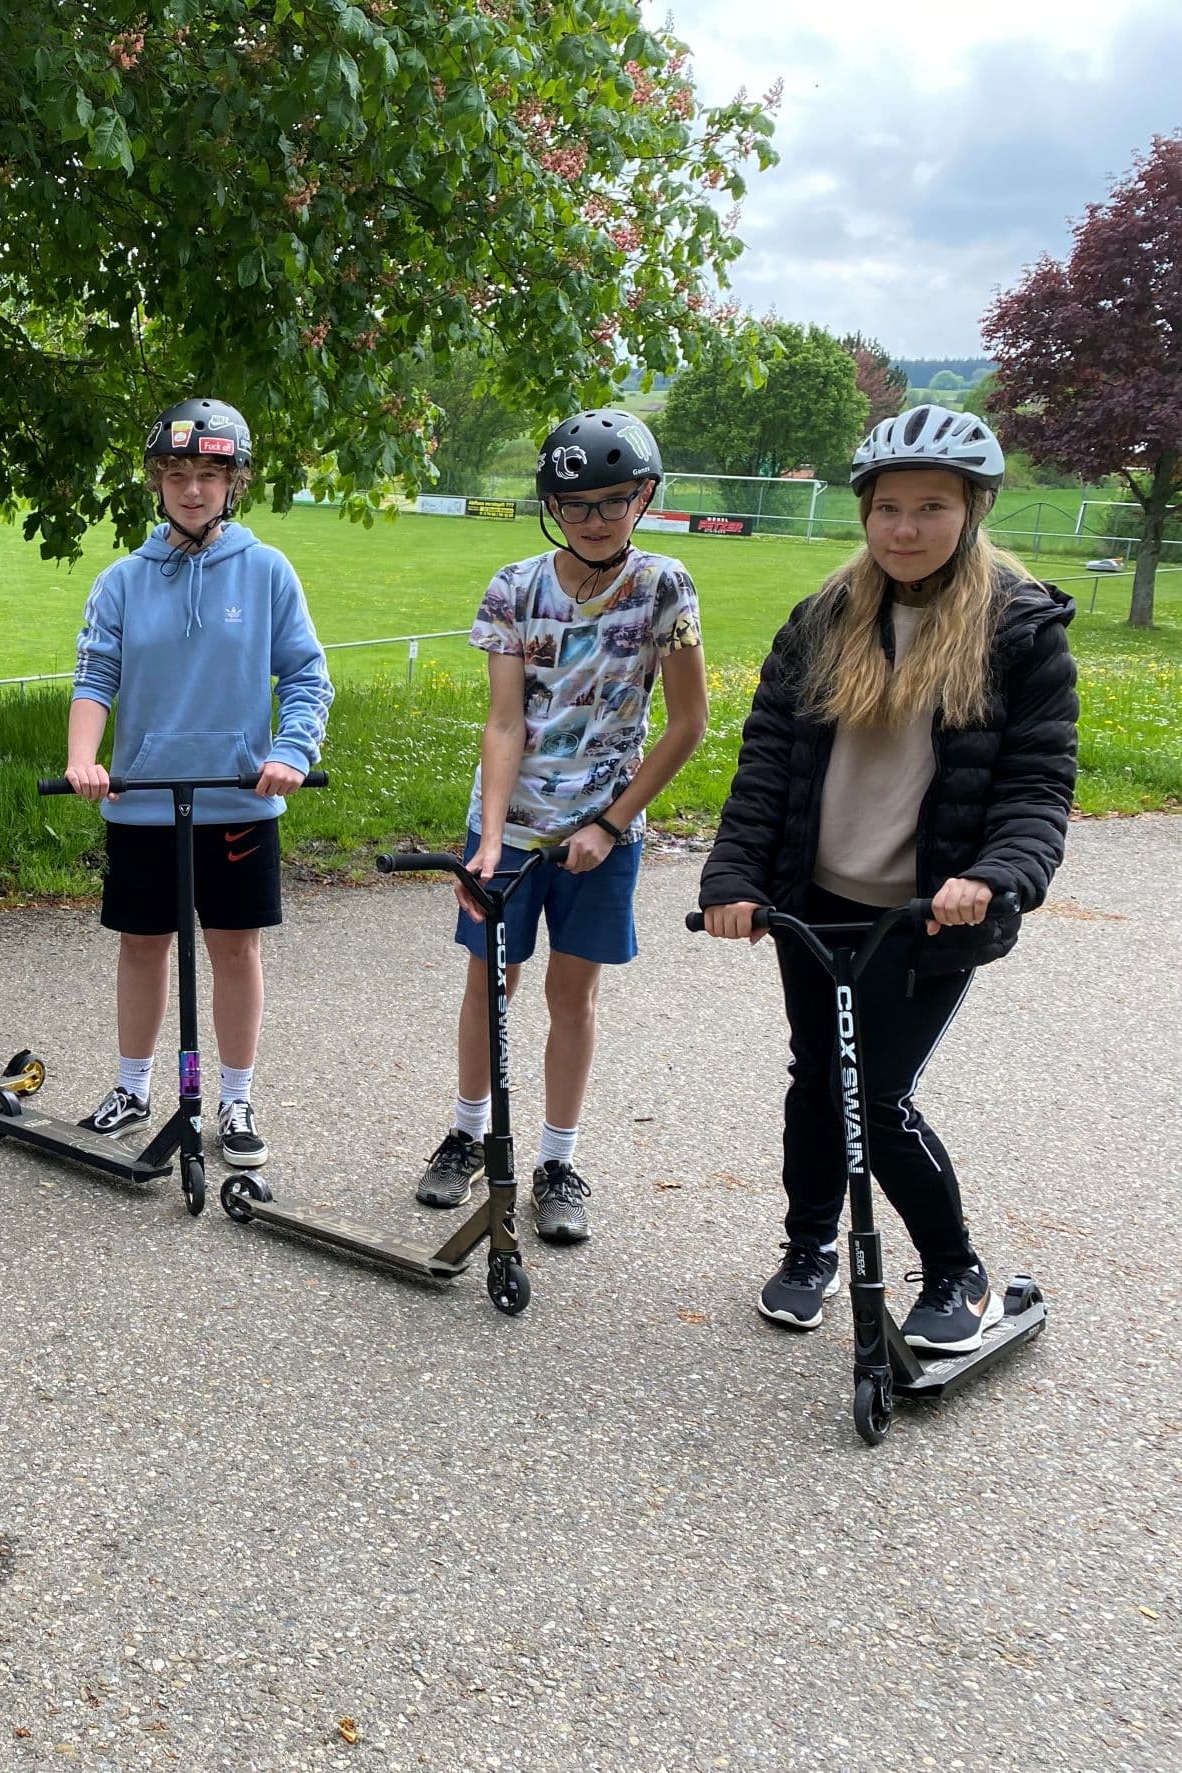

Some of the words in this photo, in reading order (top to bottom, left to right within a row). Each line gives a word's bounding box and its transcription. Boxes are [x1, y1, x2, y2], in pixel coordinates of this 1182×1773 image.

[204, 441, 220, 451] Fuck
[222, 442, 232, 452] off
[698, 520, 744, 533] FETZER
[496, 922, 507, 989] COX
[837, 985, 857, 1064] COX
[841, 1067, 865, 1174] SWAIN
